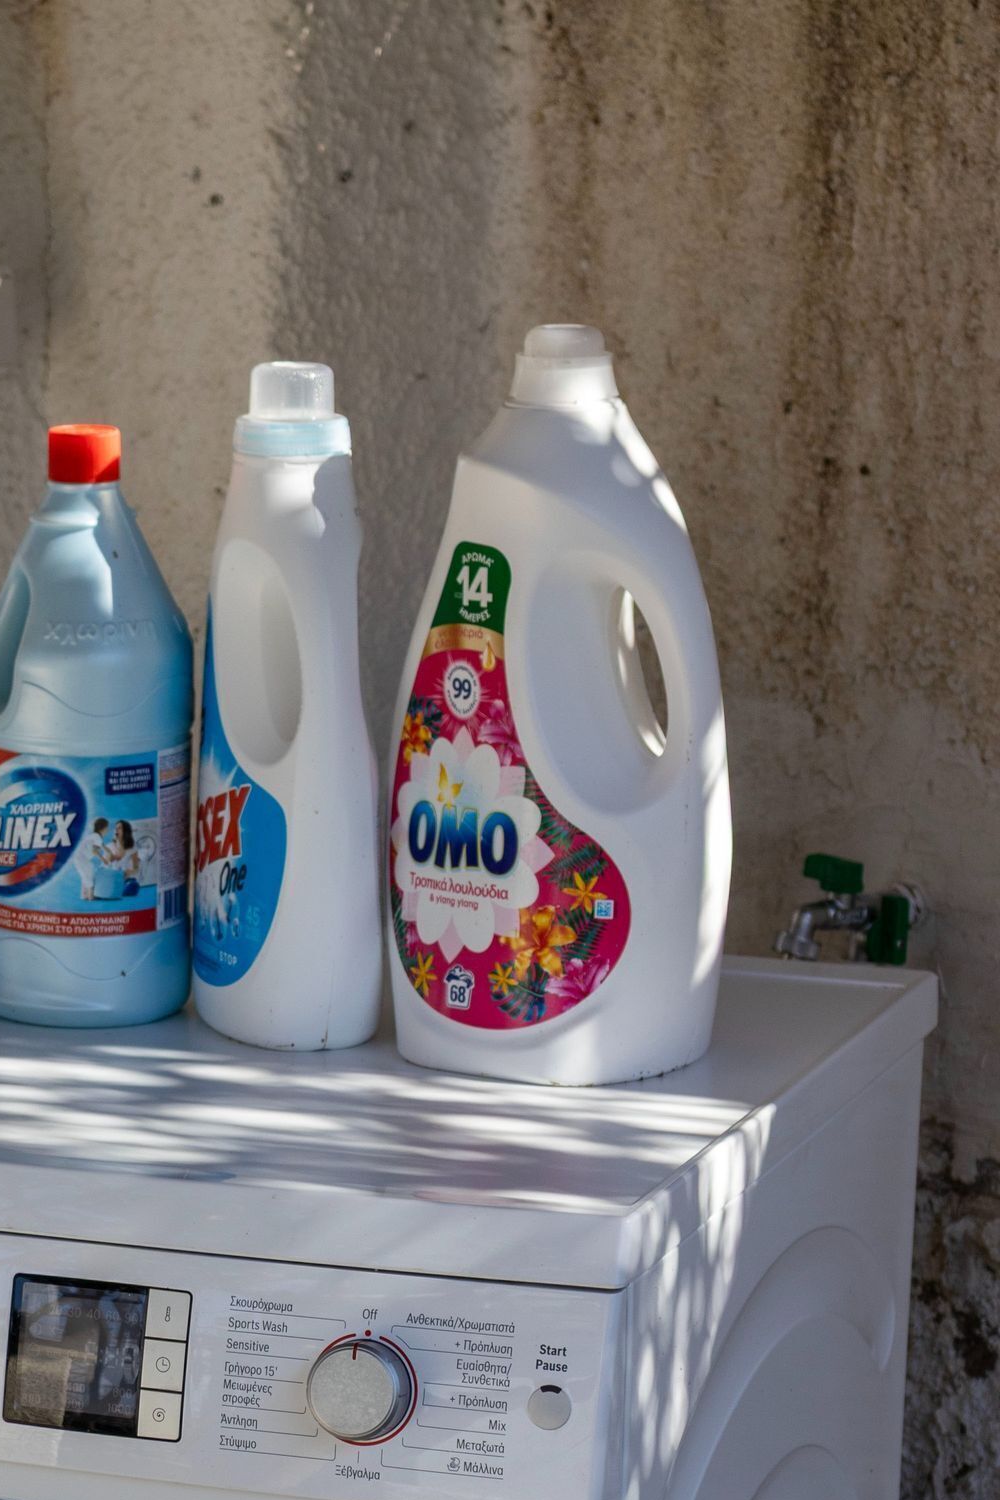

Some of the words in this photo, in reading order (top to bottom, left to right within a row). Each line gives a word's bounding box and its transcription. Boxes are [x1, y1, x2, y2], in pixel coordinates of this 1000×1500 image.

[456, 565, 494, 608] 14
[458, 606, 491, 623] ΗΜΕΡΕΣ
[452, 677, 472, 700] 99
[10, 802, 64, 815] ΧΛΩΡΙΝΗ
[195, 784, 251, 873] SEX
[408, 800, 519, 876] OMO
[219, 861, 247, 896] One
[409, 872, 447, 892] Τροπικά
[448, 877, 509, 900] λουλούδια
[436, 894, 456, 907] ylang
[457, 898, 479, 910] ylang
[69, 915, 130, 925] ΑΠΟΛΥΜΑΙΝΕΙ
[450, 984, 466, 1004] 68
[230, 1296, 293, 1312] Σκουρόχρωμα
[362, 1308, 378, 1320] Off
[228, 1317, 260, 1331] Sports
[262, 1320, 288, 1333] Wash
[406, 1313, 515, 1334] Ανθεκτικά/Χρωματιστά
[226, 1338, 270, 1353] Sensitive
[463, 1340, 513, 1356] Πρόπλυση
[539, 1344, 567, 1357] Start
[224, 1361, 262, 1377] Γρήγορο
[265, 1366, 278, 1377] 15'
[456, 1359, 512, 1375] Ευαίσθητα/
[535, 1359, 568, 1373] Pause
[223, 1379, 273, 1395] Μειωμένες
[461, 1373, 510, 1388] Συνθετικά
[222, 1393, 261, 1408] στροφές
[458, 1395, 508, 1411] Πρόπλυση
[220, 1414, 258, 1429] Άντληση
[488, 1420, 506, 1432] Mix
[219, 1435, 257, 1450] Στύψιμο
[456, 1439, 505, 1454] Μεταξωτά
[335, 1465, 381, 1480] Ξέβγαλμα
[463, 1462, 504, 1476] Μάλλινα
